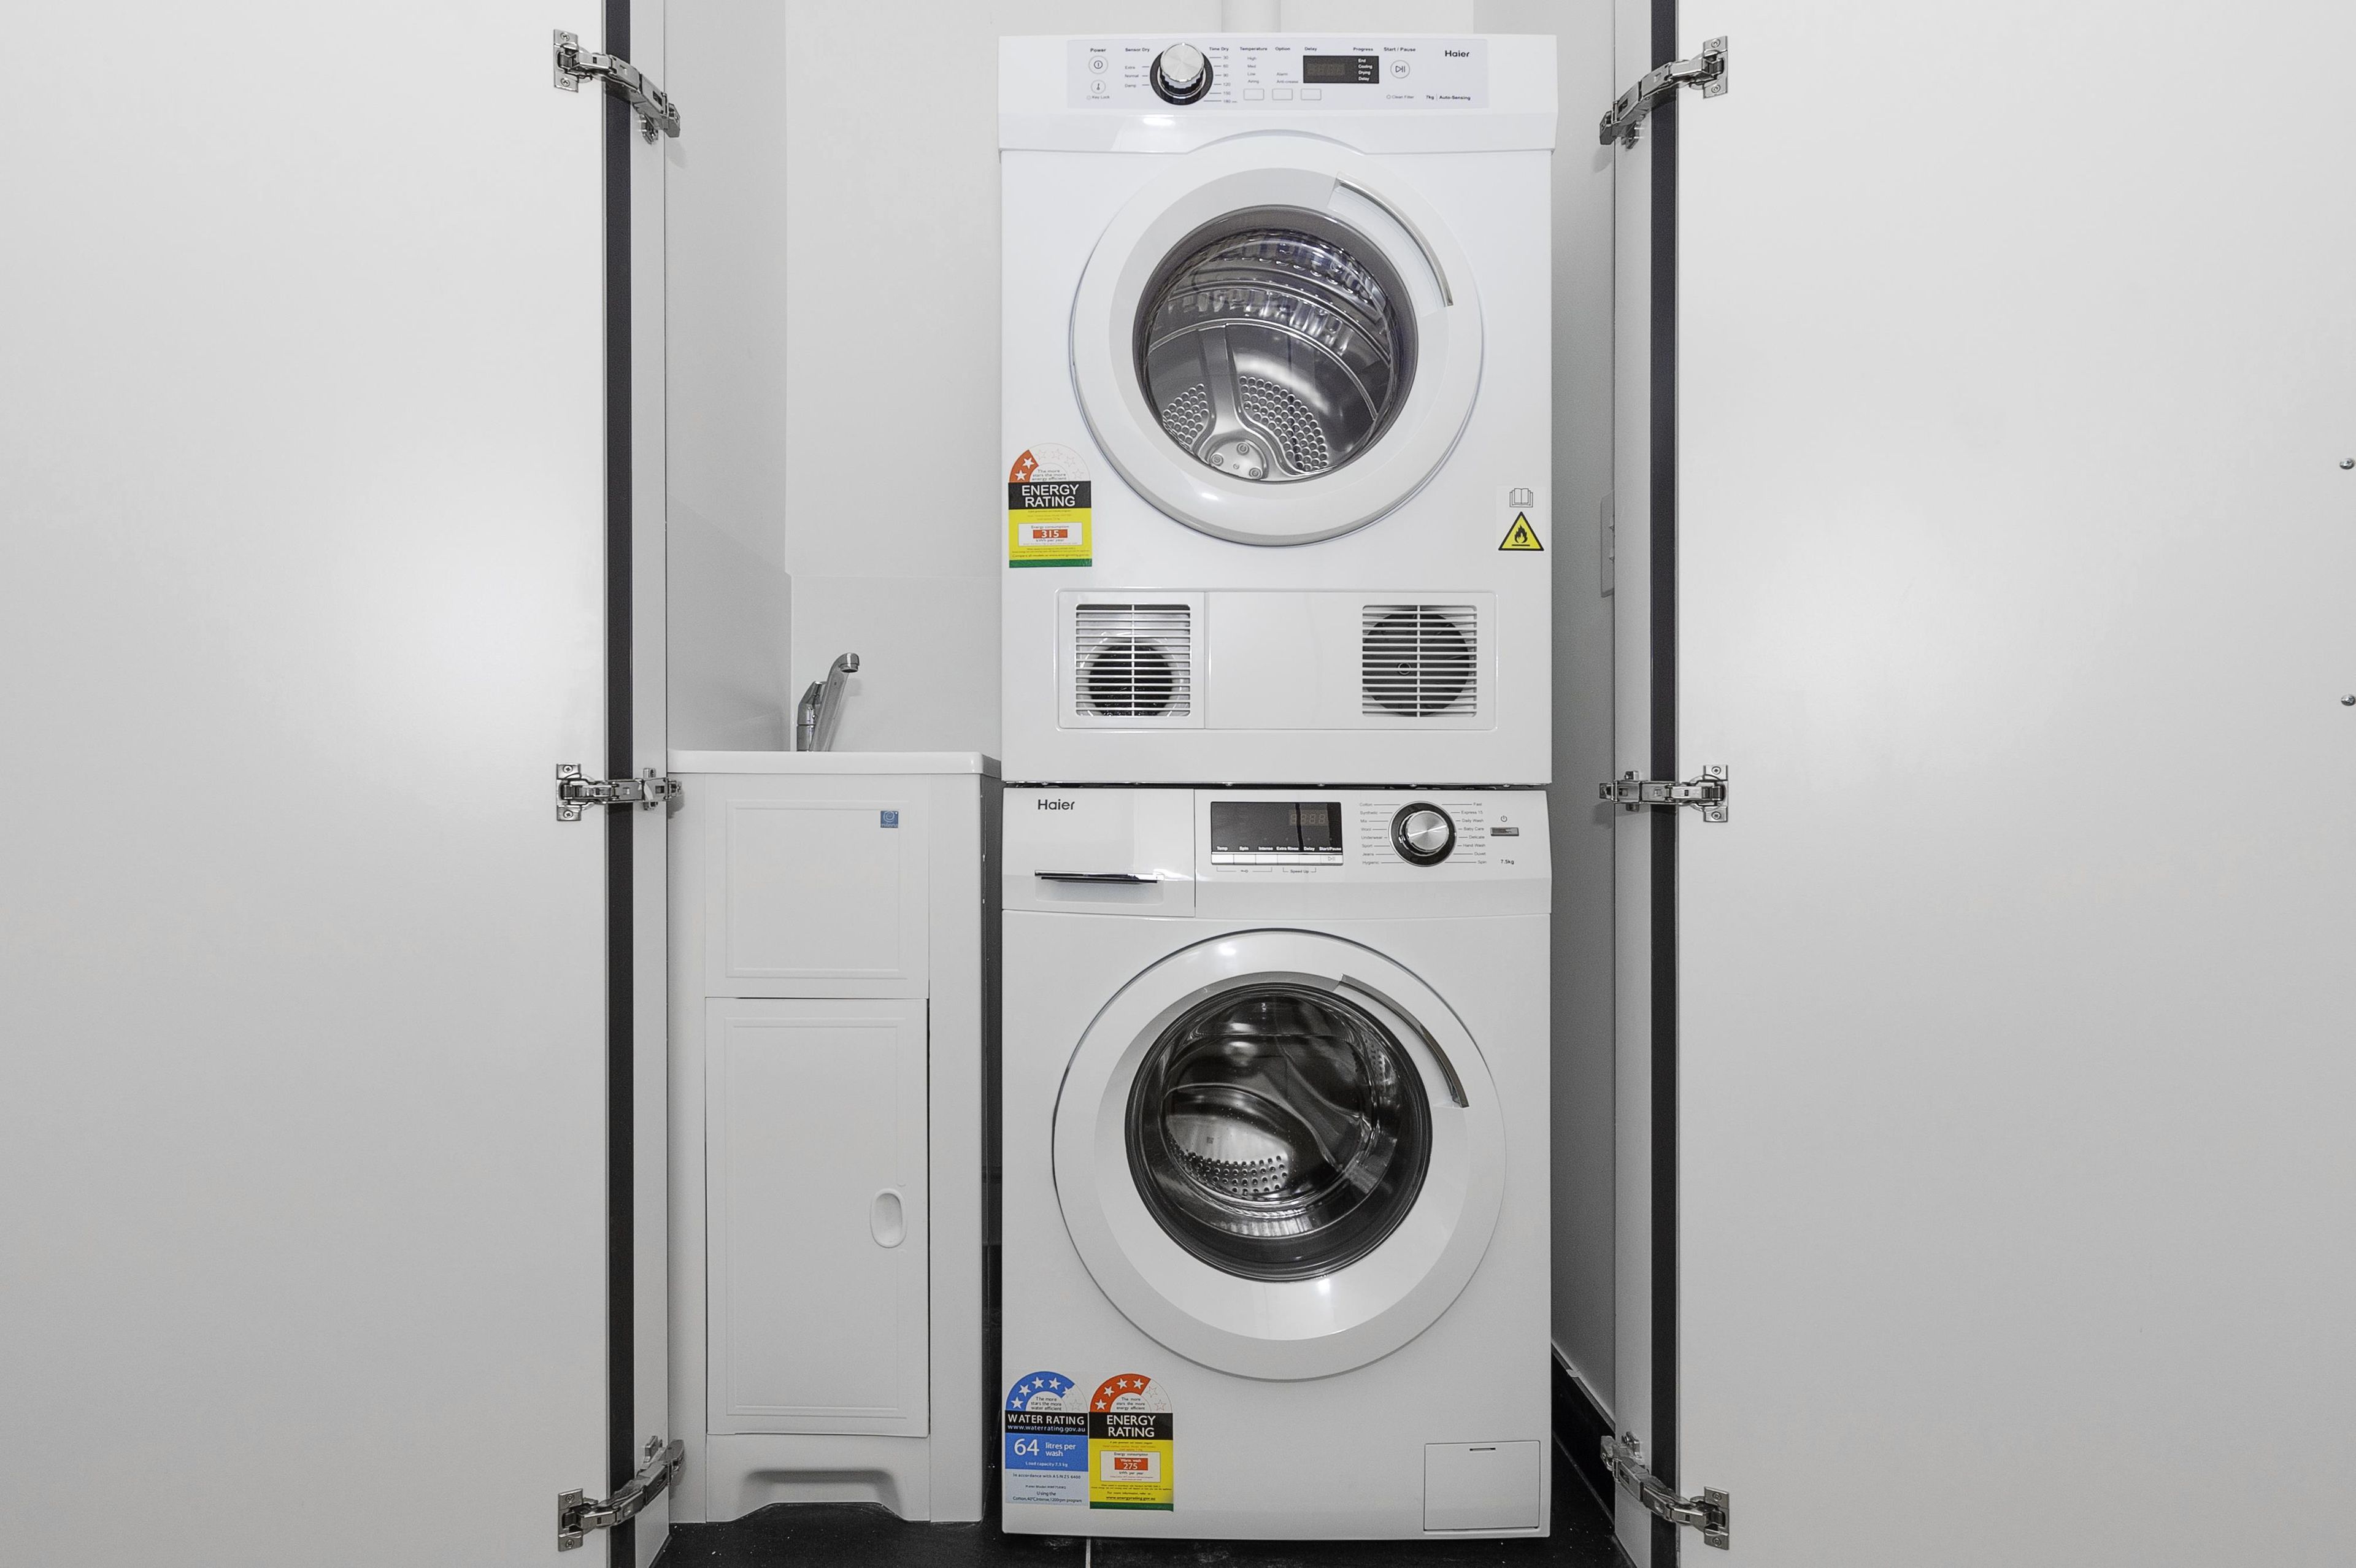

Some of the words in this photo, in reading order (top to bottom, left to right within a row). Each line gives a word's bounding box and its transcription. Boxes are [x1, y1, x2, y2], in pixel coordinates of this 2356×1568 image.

[1022, 484, 1079, 496] ENERGY
[1025, 496, 1076, 507] RATING
[1037, 799, 1075, 810] Haier
[1007, 1414, 1043, 1424] WATER
[1046, 1415, 1085, 1425] RATING
[1107, 1415, 1156, 1426] ENERGY
[1007, 1424, 1086, 1433] www.waterrating.gov.au
[1108, 1427, 1155, 1437] RATING
[1014, 1438, 1040, 1456] 64
